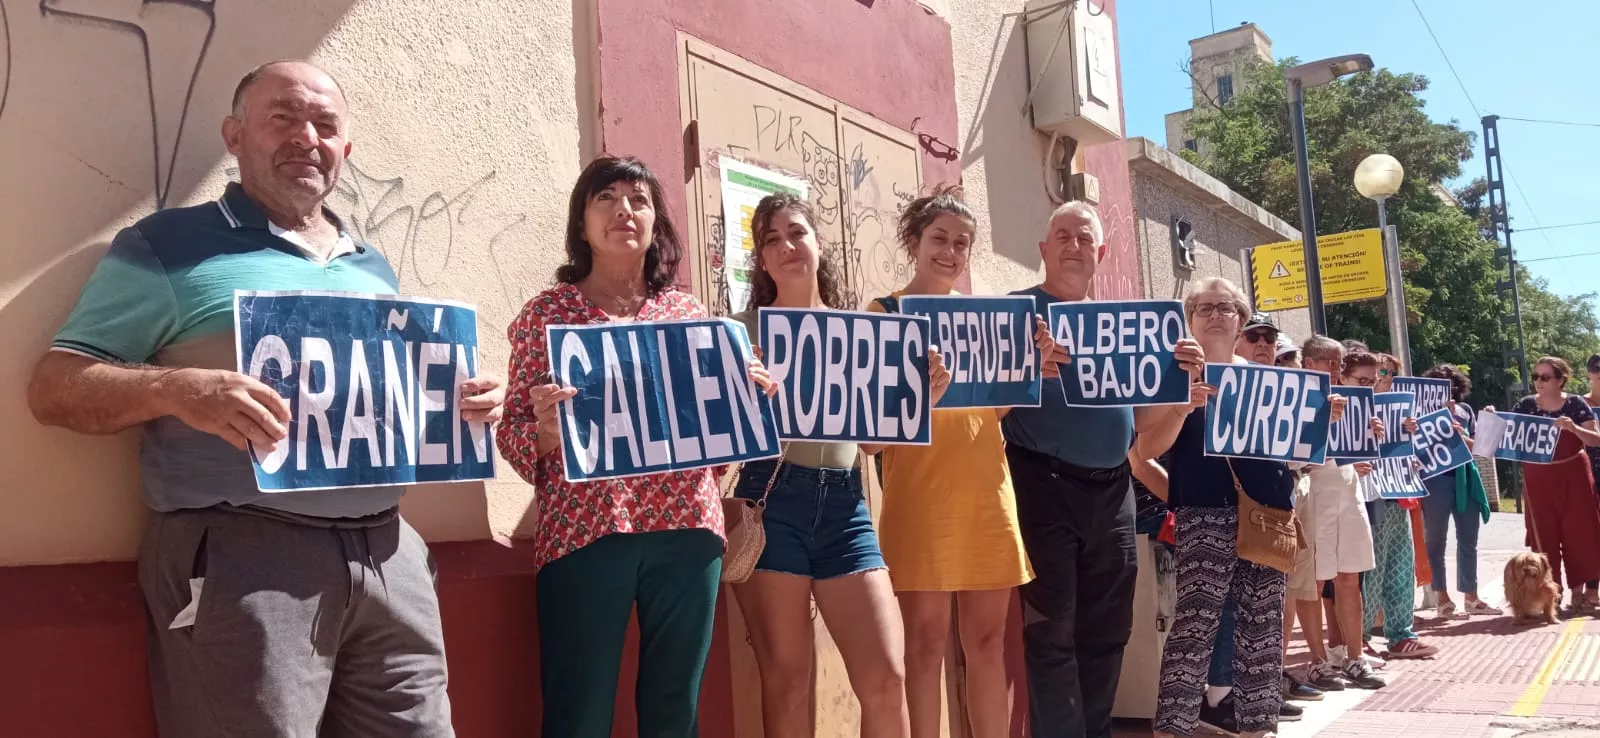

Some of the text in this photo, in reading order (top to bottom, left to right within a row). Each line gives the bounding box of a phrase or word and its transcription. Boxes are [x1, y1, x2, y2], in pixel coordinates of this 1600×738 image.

[1331, 250, 1367, 262] ATENCIÓN!
[913, 311, 1036, 383] BERUELA
[1056, 310, 1183, 355] ALBERO
[249, 307, 488, 474] GRAÑÉN
[560, 325, 768, 474] CALLEN
[767, 313, 922, 440] ROBRES
[1077, 354, 1161, 399] BAJO
[1212, 367, 1320, 458] CURBE
[1499, 420, 1558, 455] RACES
